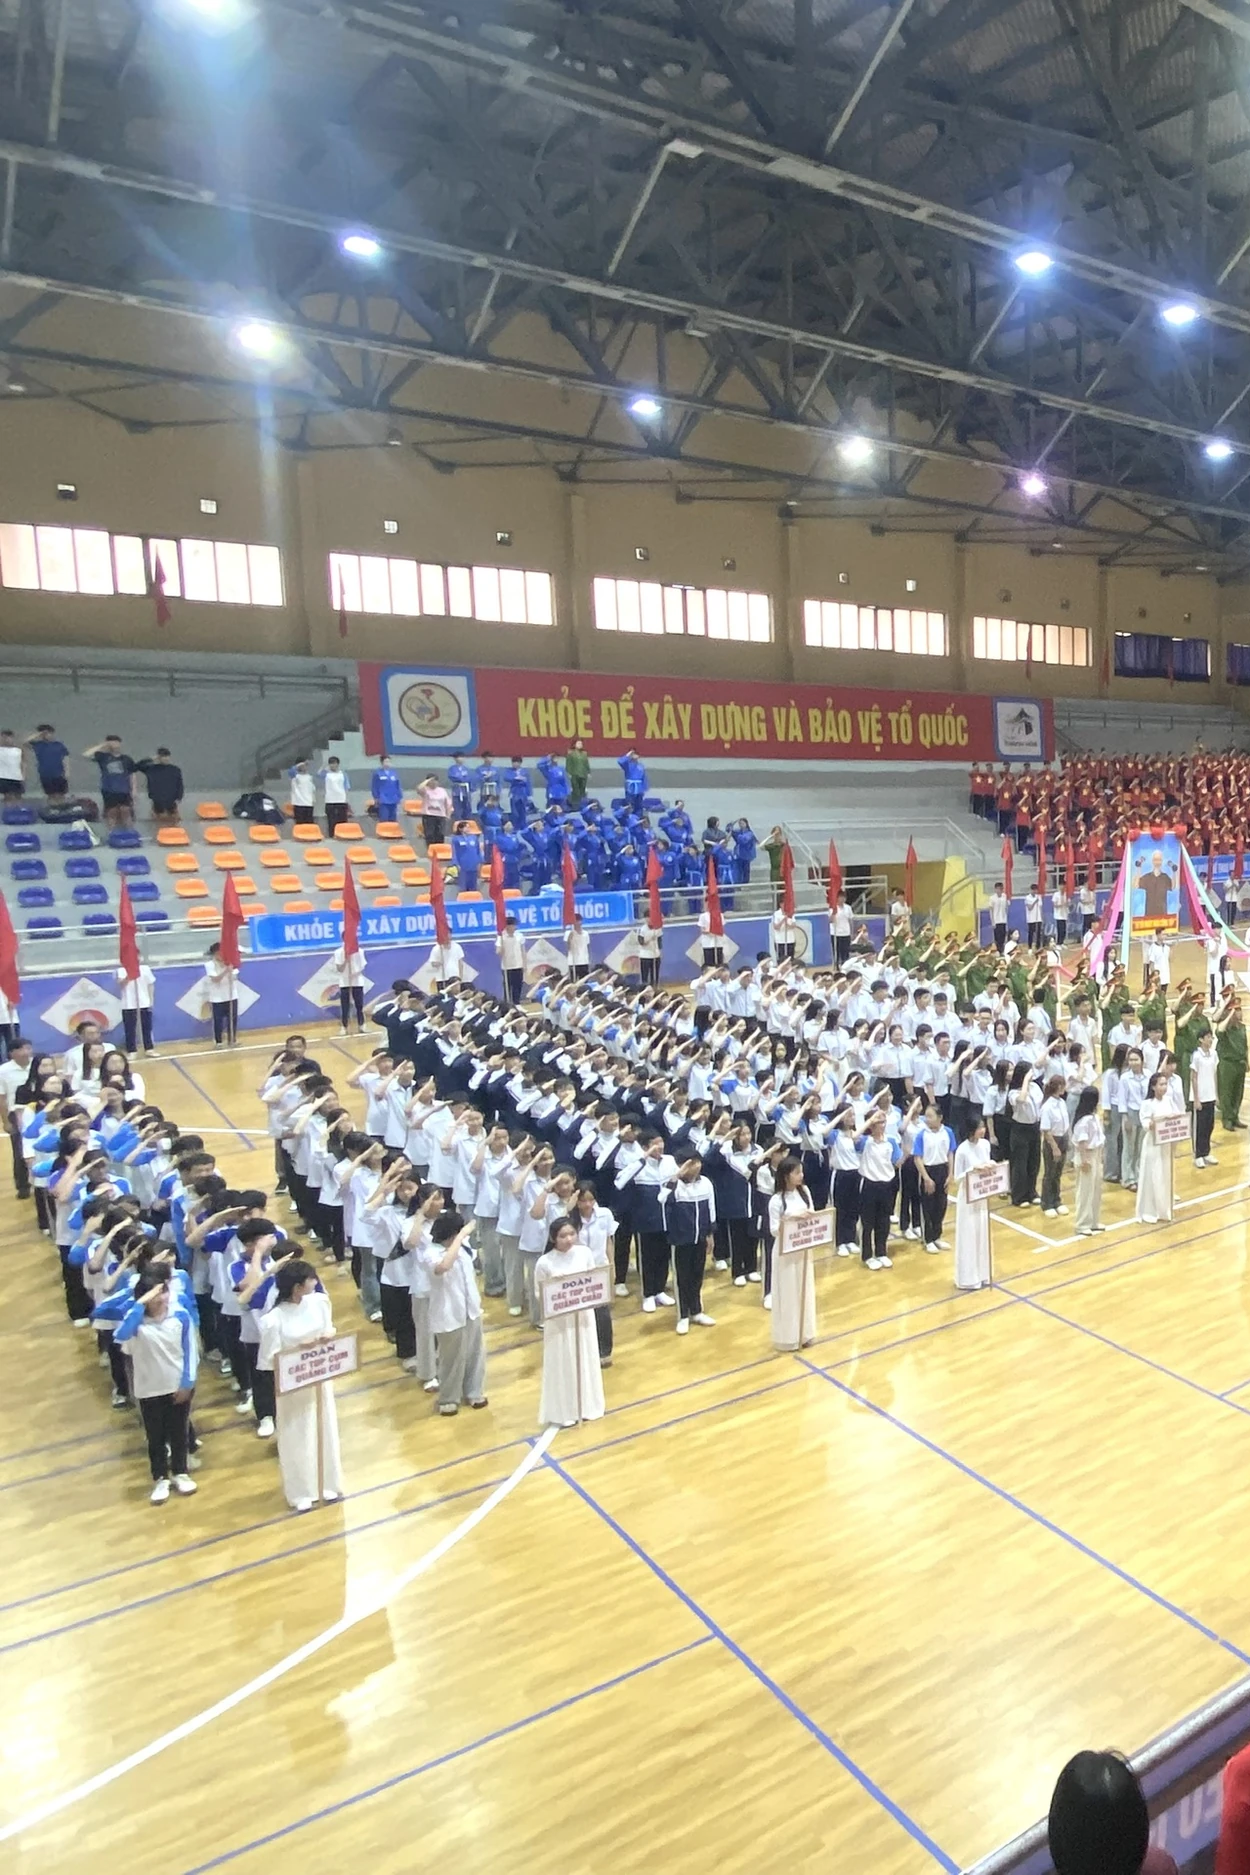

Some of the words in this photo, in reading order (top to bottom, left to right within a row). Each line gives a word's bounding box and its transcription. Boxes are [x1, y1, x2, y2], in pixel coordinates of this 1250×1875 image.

[517, 685, 594, 738] KHỎE
[600, 685, 636, 739] ĐỂ
[643, 694, 692, 740] XÂY
[700, 701, 768, 749] DỰNG
[773, 699, 804, 743] VÀ
[808, 697, 852, 744] BẢO
[857, 703, 883, 752] VỆ
[887, 699, 913, 745] TỔ
[918, 702, 968, 749] QUỐC
[284, 917, 335, 942] KHỎE
[366, 914, 401, 935] XÂY
[456, 907, 479, 928] VÀ
[517, 904, 537, 926] VỆ
[541, 902, 561, 923] TỔ
[551, 1291, 567, 1301] CÁC
[585, 1282, 604, 1293] CỤM
[562, 1276, 592, 1290] ĐOÀN
[553, 1297, 580, 1311] QUẢNG
[300, 1343, 336, 1361] ĐOÀN
[288, 1363, 307, 1375] CÁC
[328, 1350, 349, 1362] CỤM
[295, 1367, 327, 1383] QUẢNG
